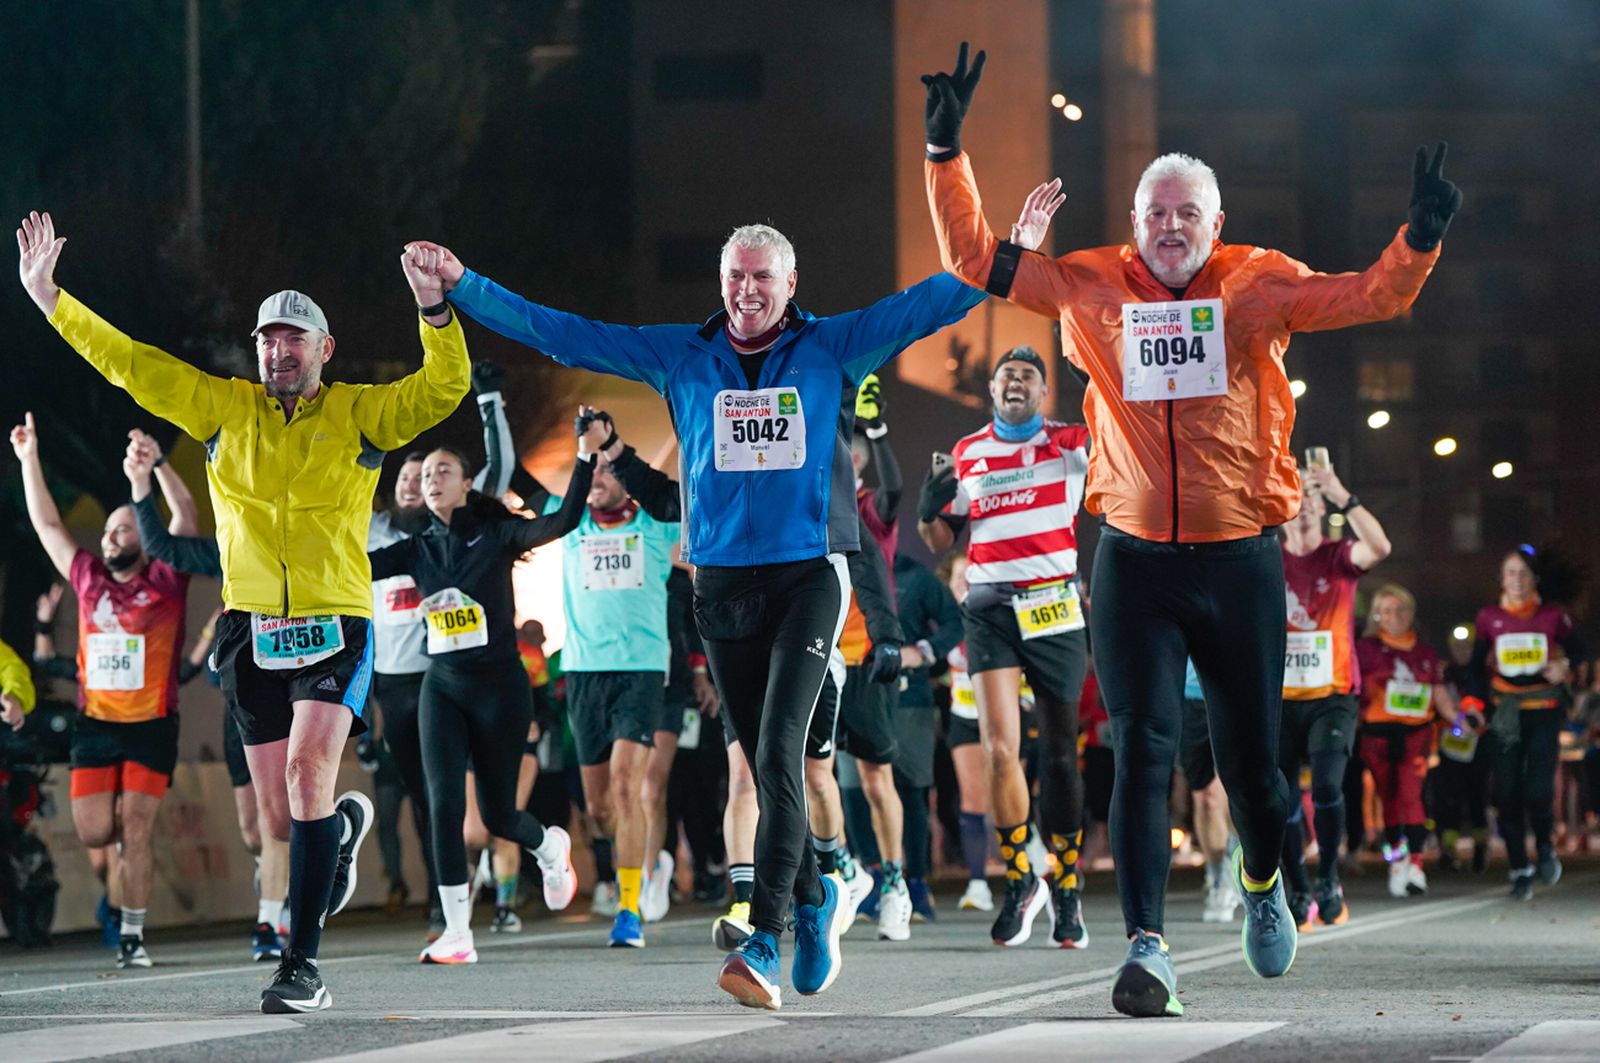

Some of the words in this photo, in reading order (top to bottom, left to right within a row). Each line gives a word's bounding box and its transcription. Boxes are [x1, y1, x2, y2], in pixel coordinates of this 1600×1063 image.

[1141, 313, 1167, 323] NOCHE
[1169, 312, 1181, 322] DE
[1133, 326, 1149, 336] SAN
[1140, 335, 1206, 367] 6094
[734, 399, 759, 408] NOCHE
[760, 398, 770, 406] DE
[724, 409, 741, 418] SAN
[732, 417, 789, 443] 5042
[978, 495, 1001, 513] 100
[593, 553, 631, 571] 2130
[1030, 602, 1070, 625] 4613
[261, 621, 278, 632] SAN
[269, 625, 325, 652] 7958
[98, 655, 131, 670] 1356
[1285, 652, 1320, 668] 2105
